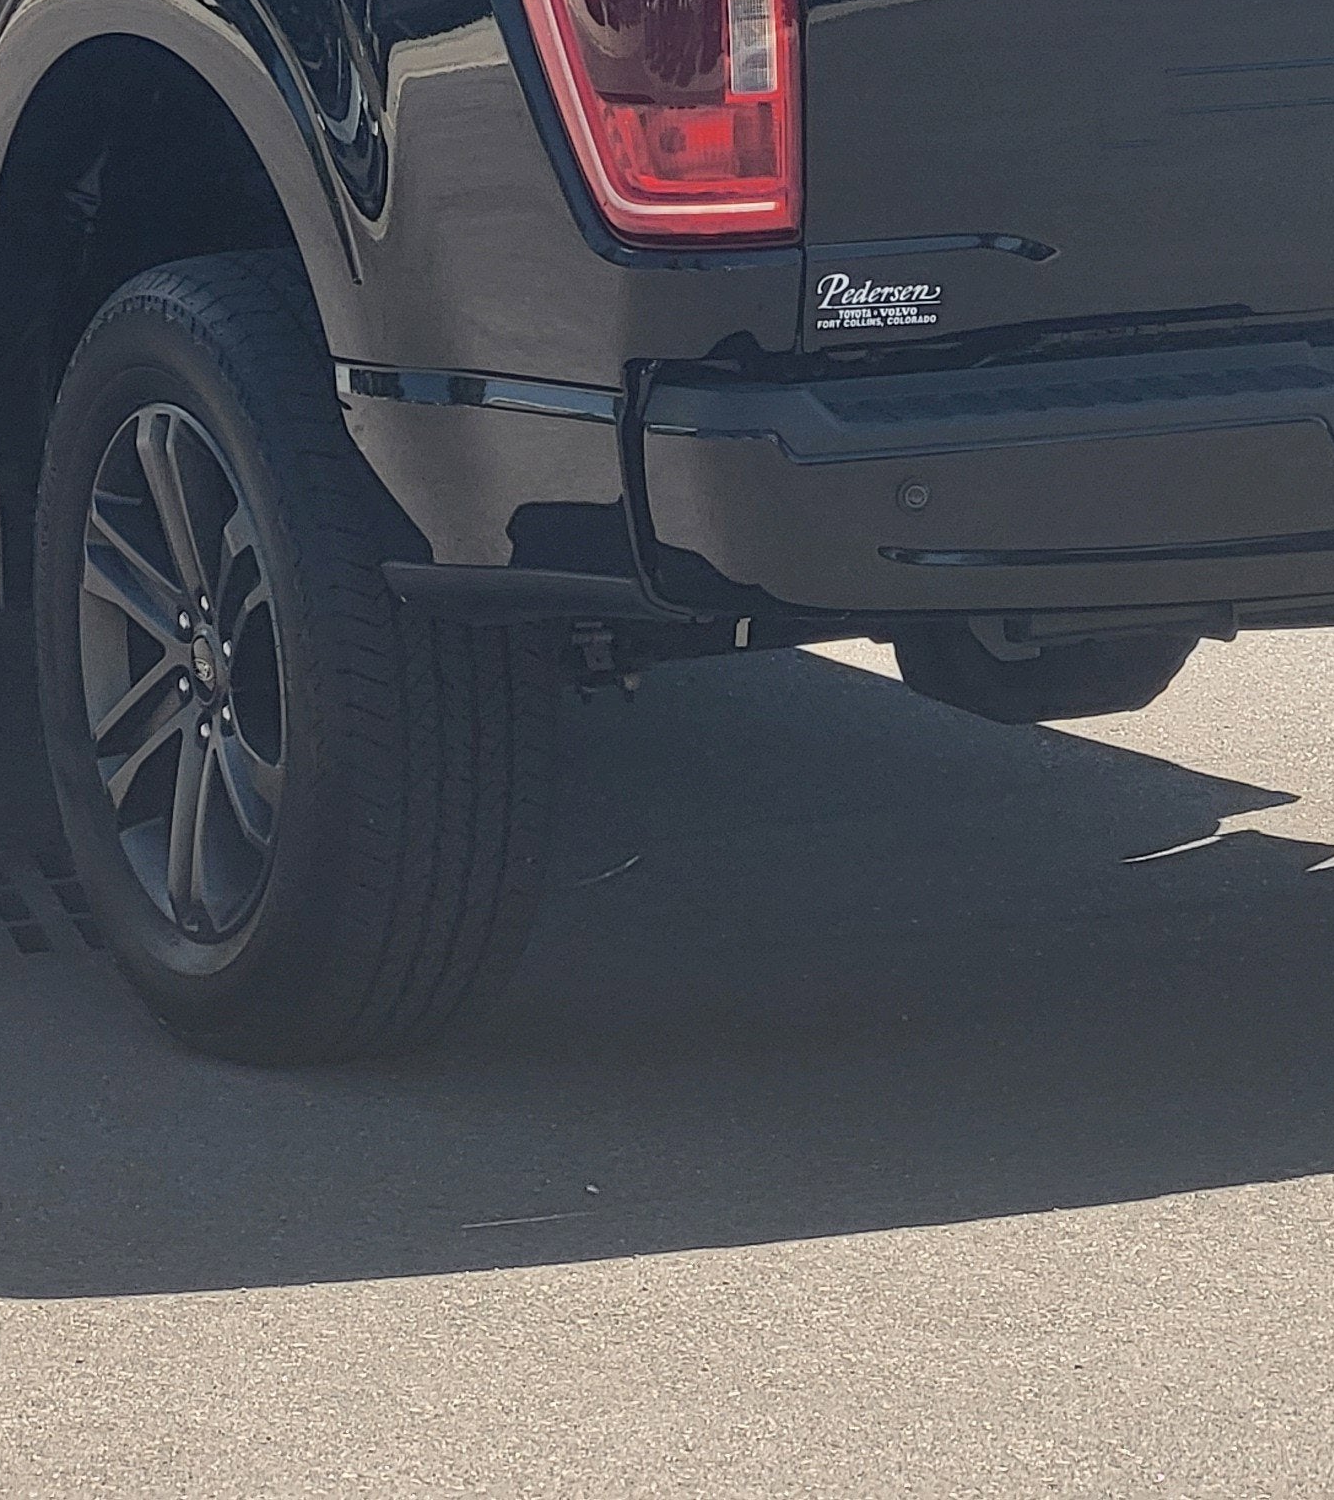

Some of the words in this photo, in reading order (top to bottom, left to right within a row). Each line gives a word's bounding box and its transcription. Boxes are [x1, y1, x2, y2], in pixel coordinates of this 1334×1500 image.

[817, 273, 941, 309] Pedersen
[880, 307, 918, 317] VOLVO
[817, 320, 841, 329] FORT
[843, 317, 884, 328] COLLINS,
[887, 315, 937, 325] COLORADO
